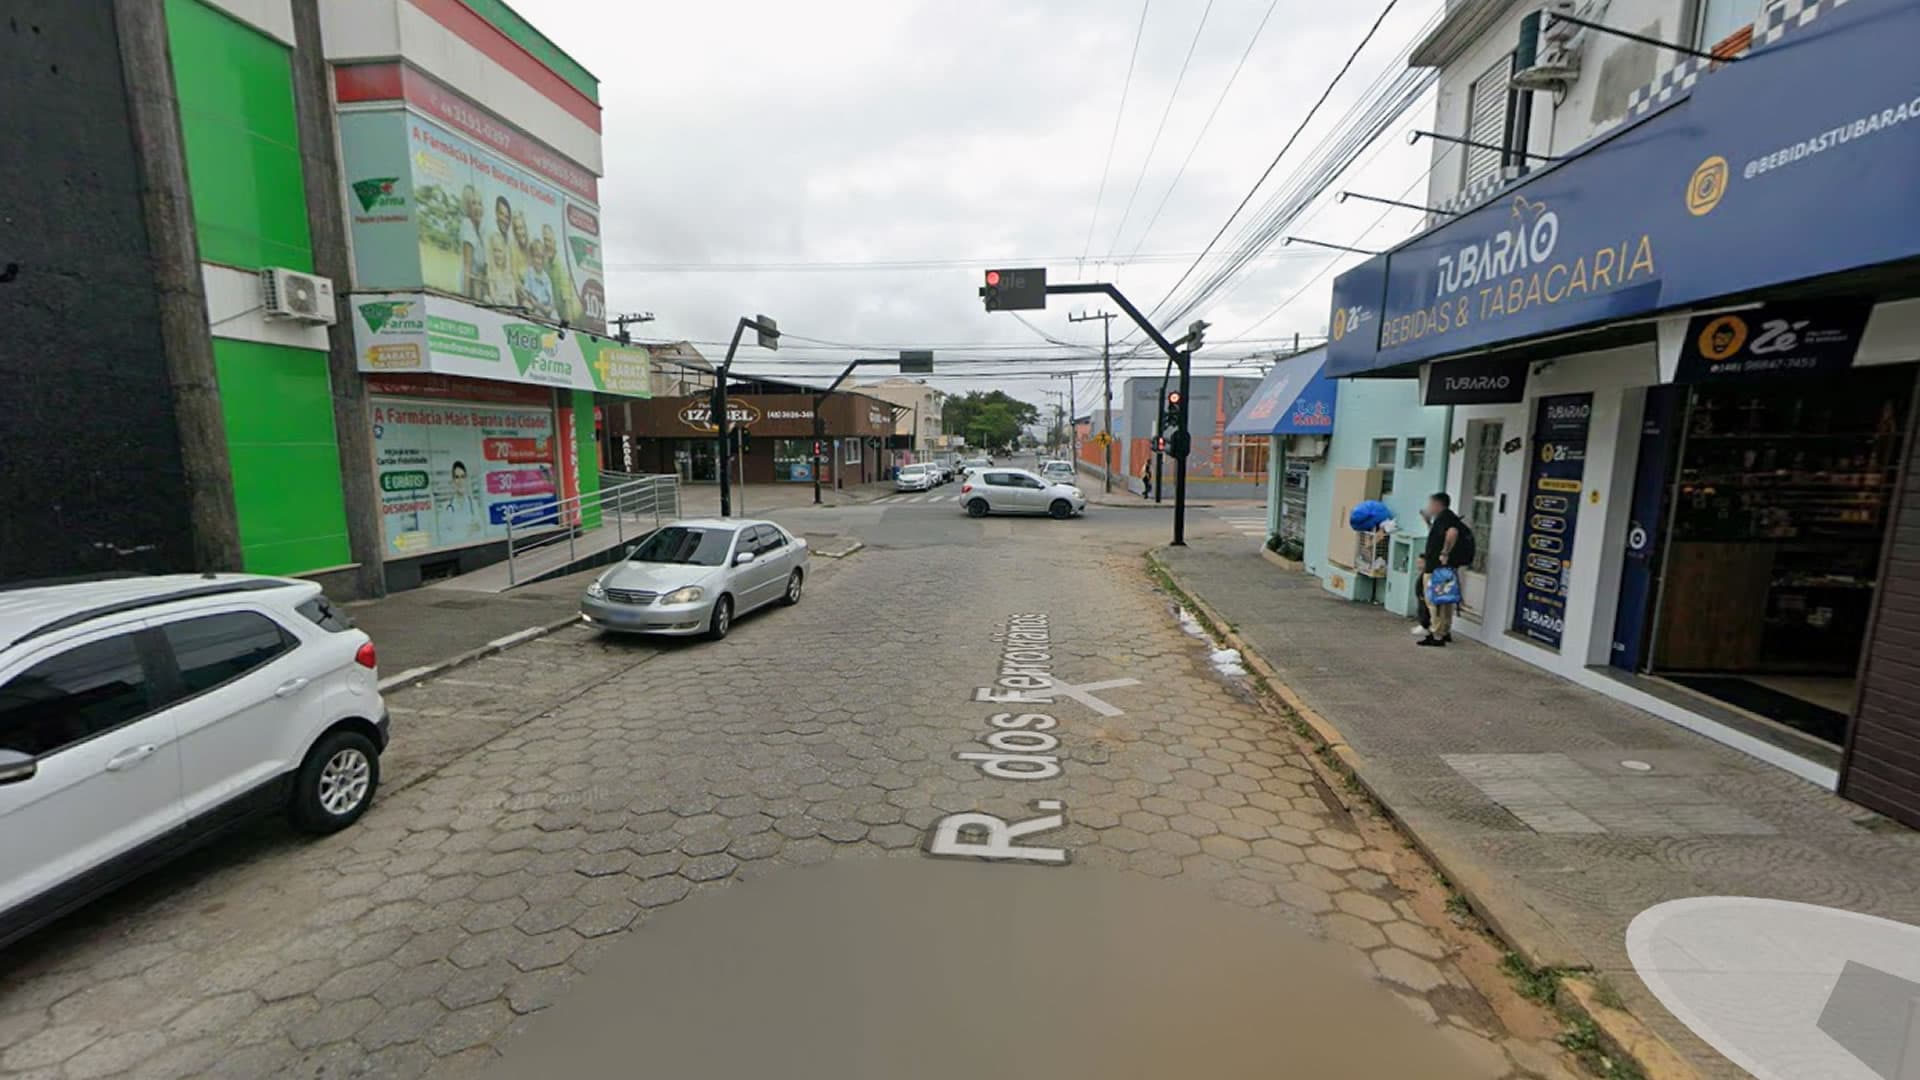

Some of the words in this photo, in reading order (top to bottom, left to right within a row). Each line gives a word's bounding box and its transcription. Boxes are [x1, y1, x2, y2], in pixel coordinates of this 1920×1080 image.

[1381, 302, 1450, 347] BEBIDAS
[1454, 296, 1469, 328] &
[1479, 234, 1655, 321] TABACARIA
[383, 320, 424, 330] Farma
[506, 327, 538, 351] Med
[1750, 319, 1810, 355] Zé
[531, 355, 573, 376] Farma
[375, 408, 384, 423] A
[387, 408, 442, 425] Farmácia
[444, 410, 469, 426] Mais
[471, 412, 503, 428] Barata
[686, 409, 753, 421] IZAEL
